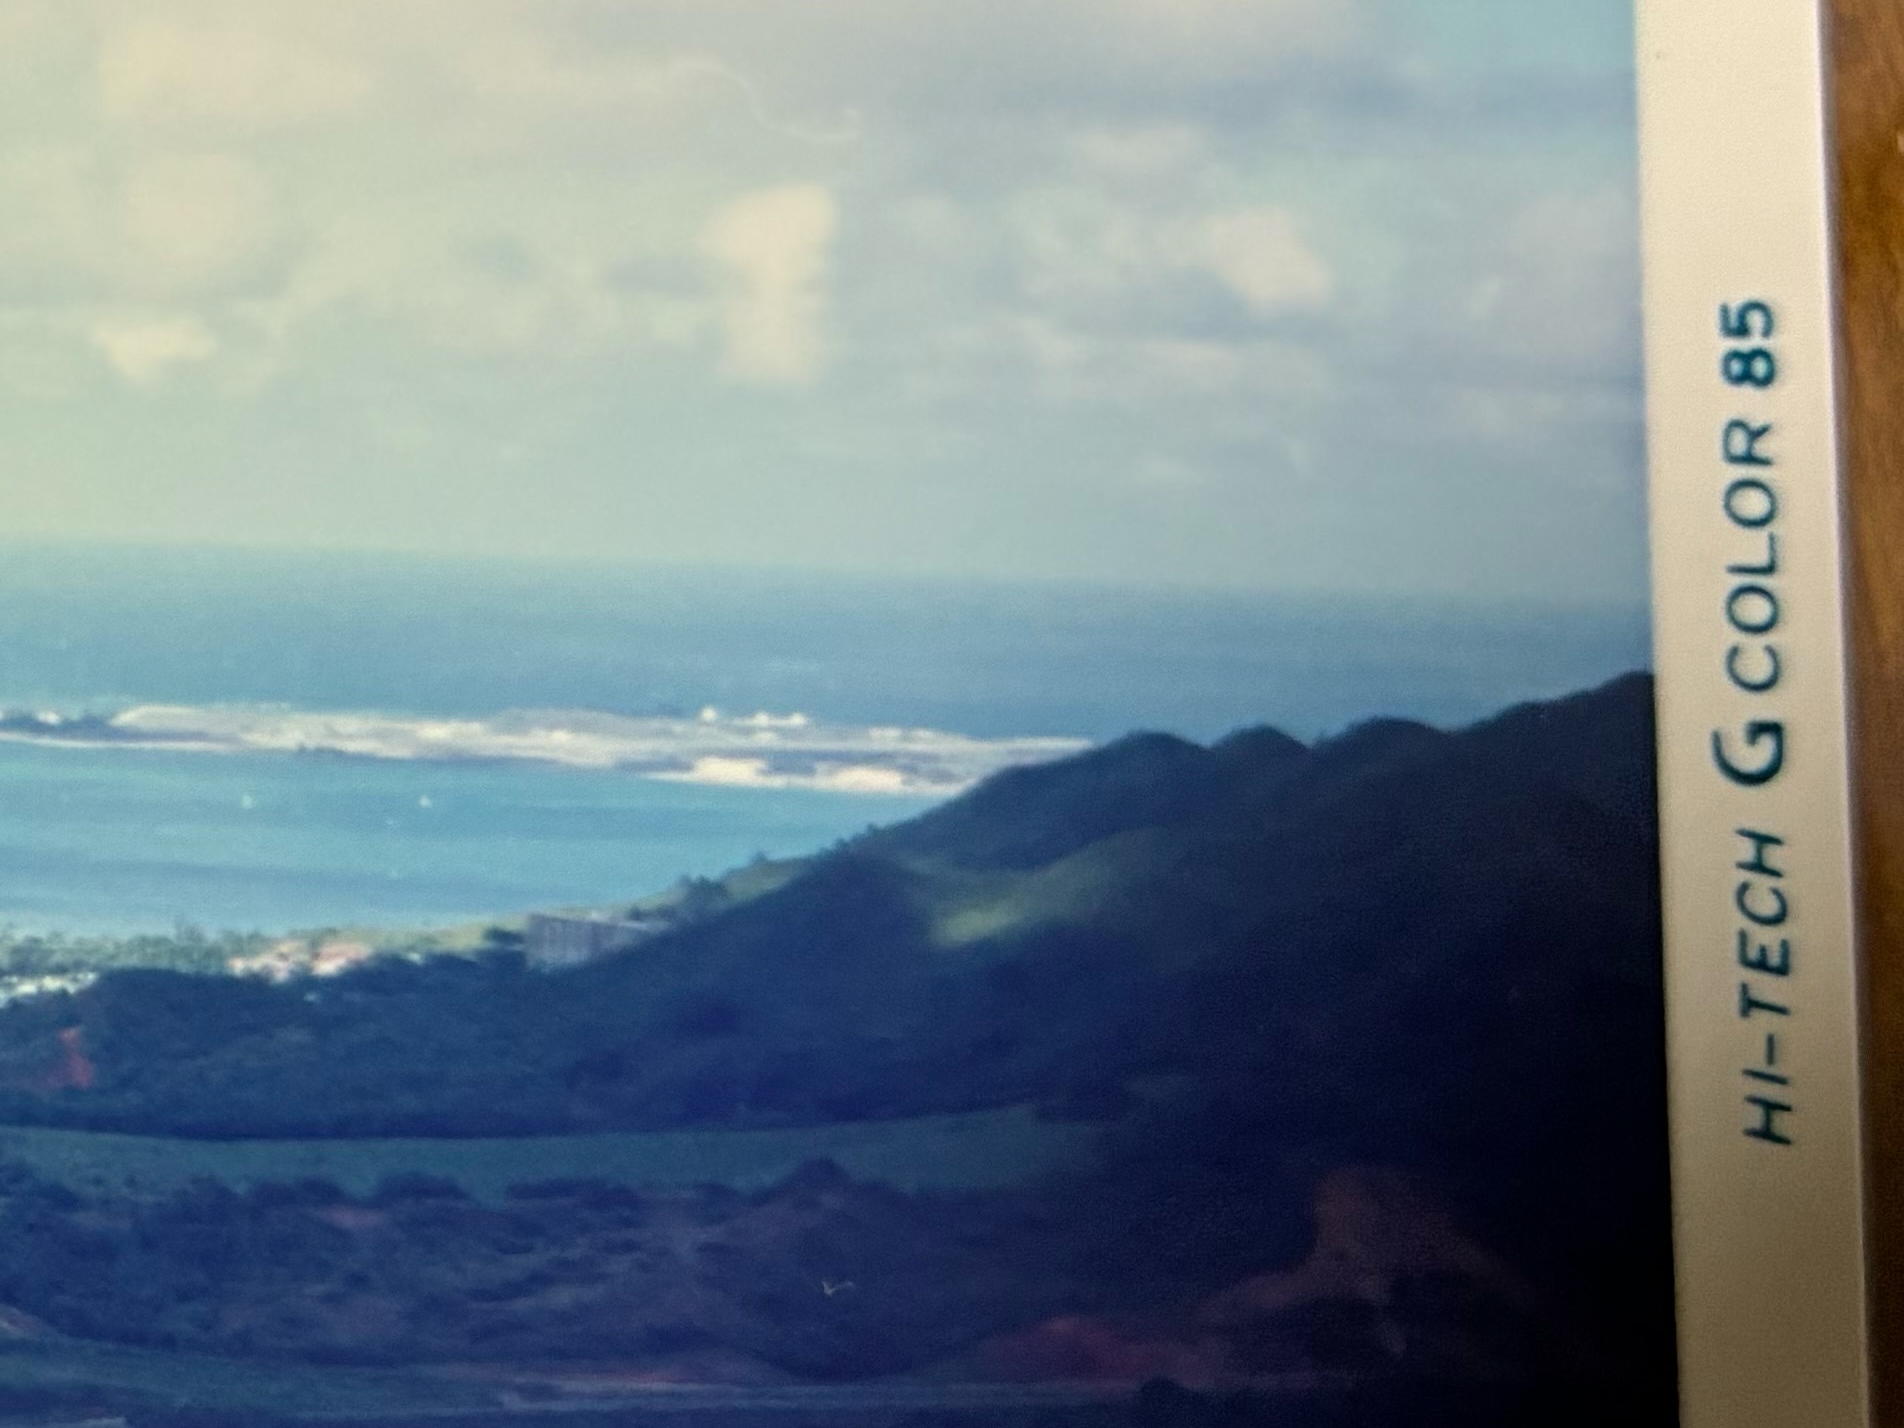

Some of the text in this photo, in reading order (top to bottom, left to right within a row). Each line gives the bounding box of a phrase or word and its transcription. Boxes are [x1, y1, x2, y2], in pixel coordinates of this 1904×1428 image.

[1712, 298, 1793, 1146] HI-TECH G COLOR 85
